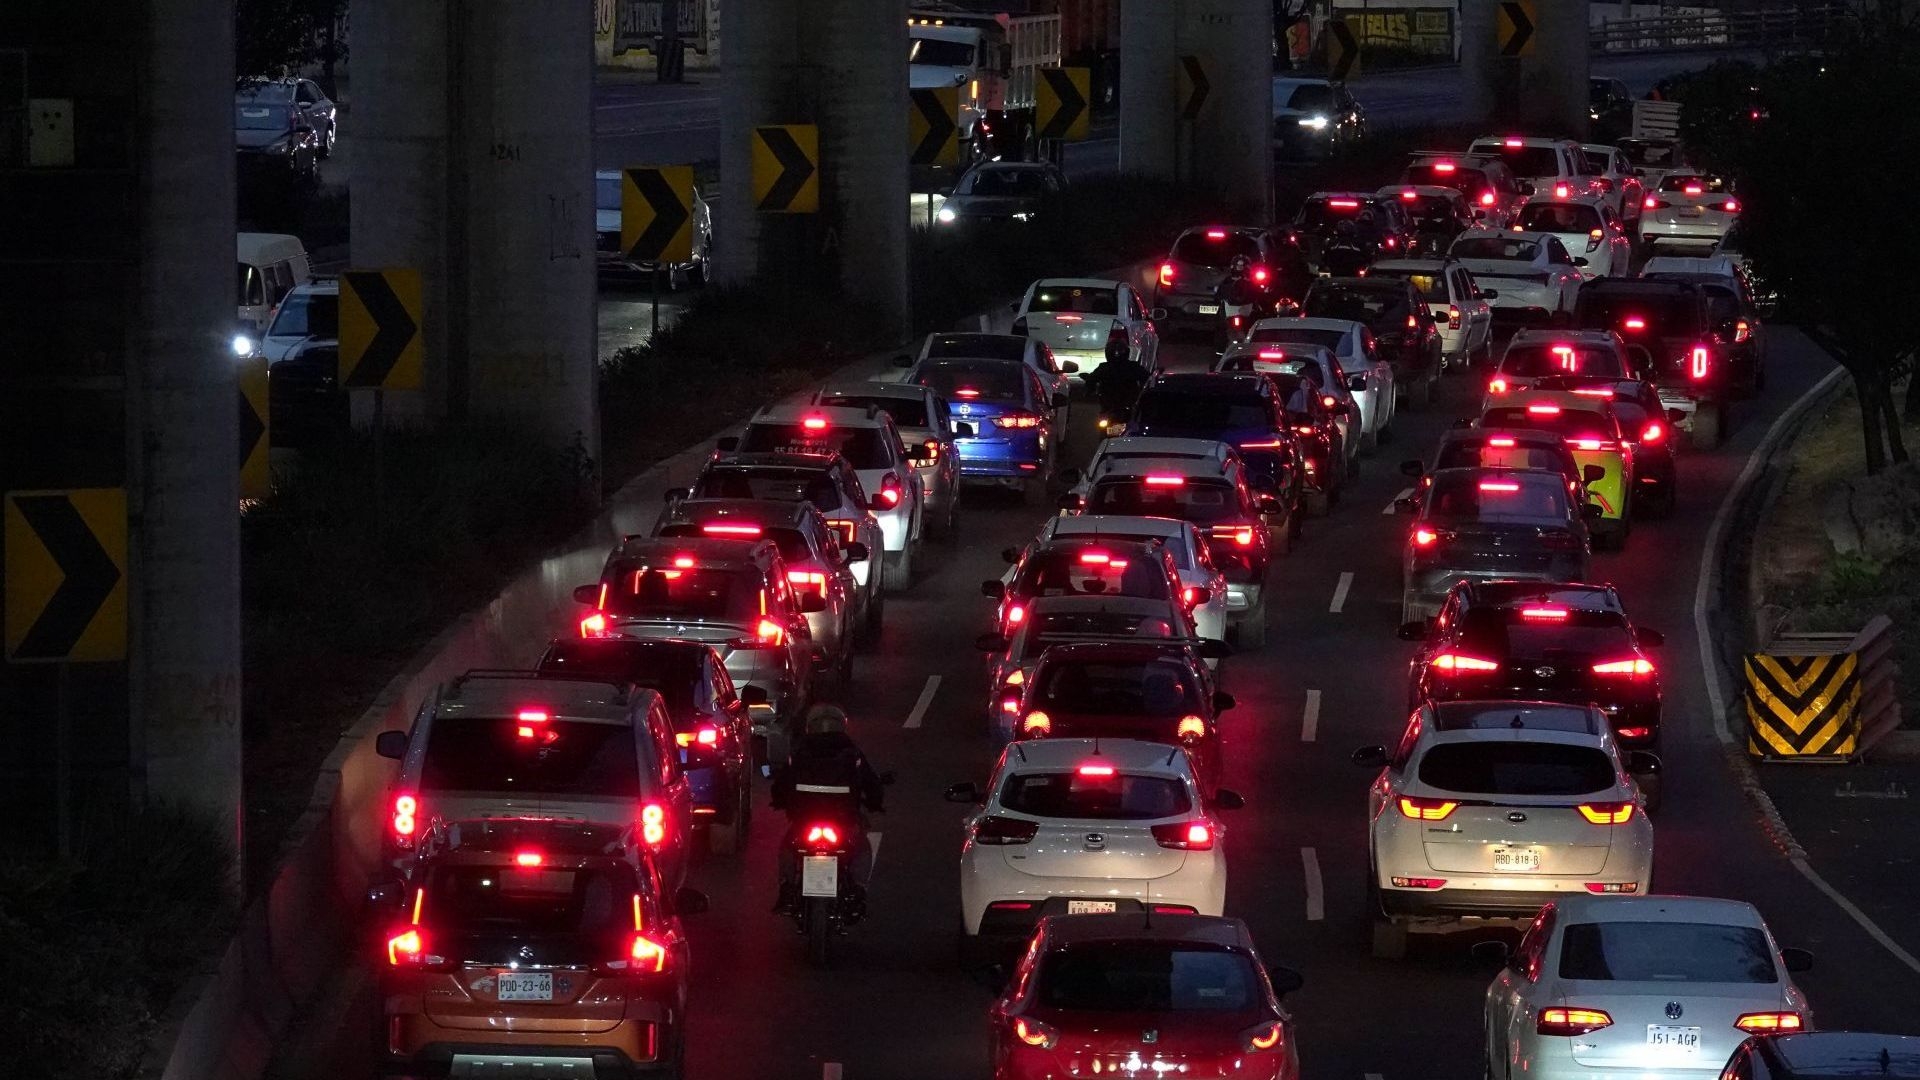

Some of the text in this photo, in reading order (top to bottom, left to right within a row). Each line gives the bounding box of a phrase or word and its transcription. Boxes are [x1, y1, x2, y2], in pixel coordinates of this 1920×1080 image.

[1495, 854, 1539, 866] RBD-818-B
[500, 980, 551, 992] PDD-23-66
[1651, 1033, 1698, 1046] J51-AGP
